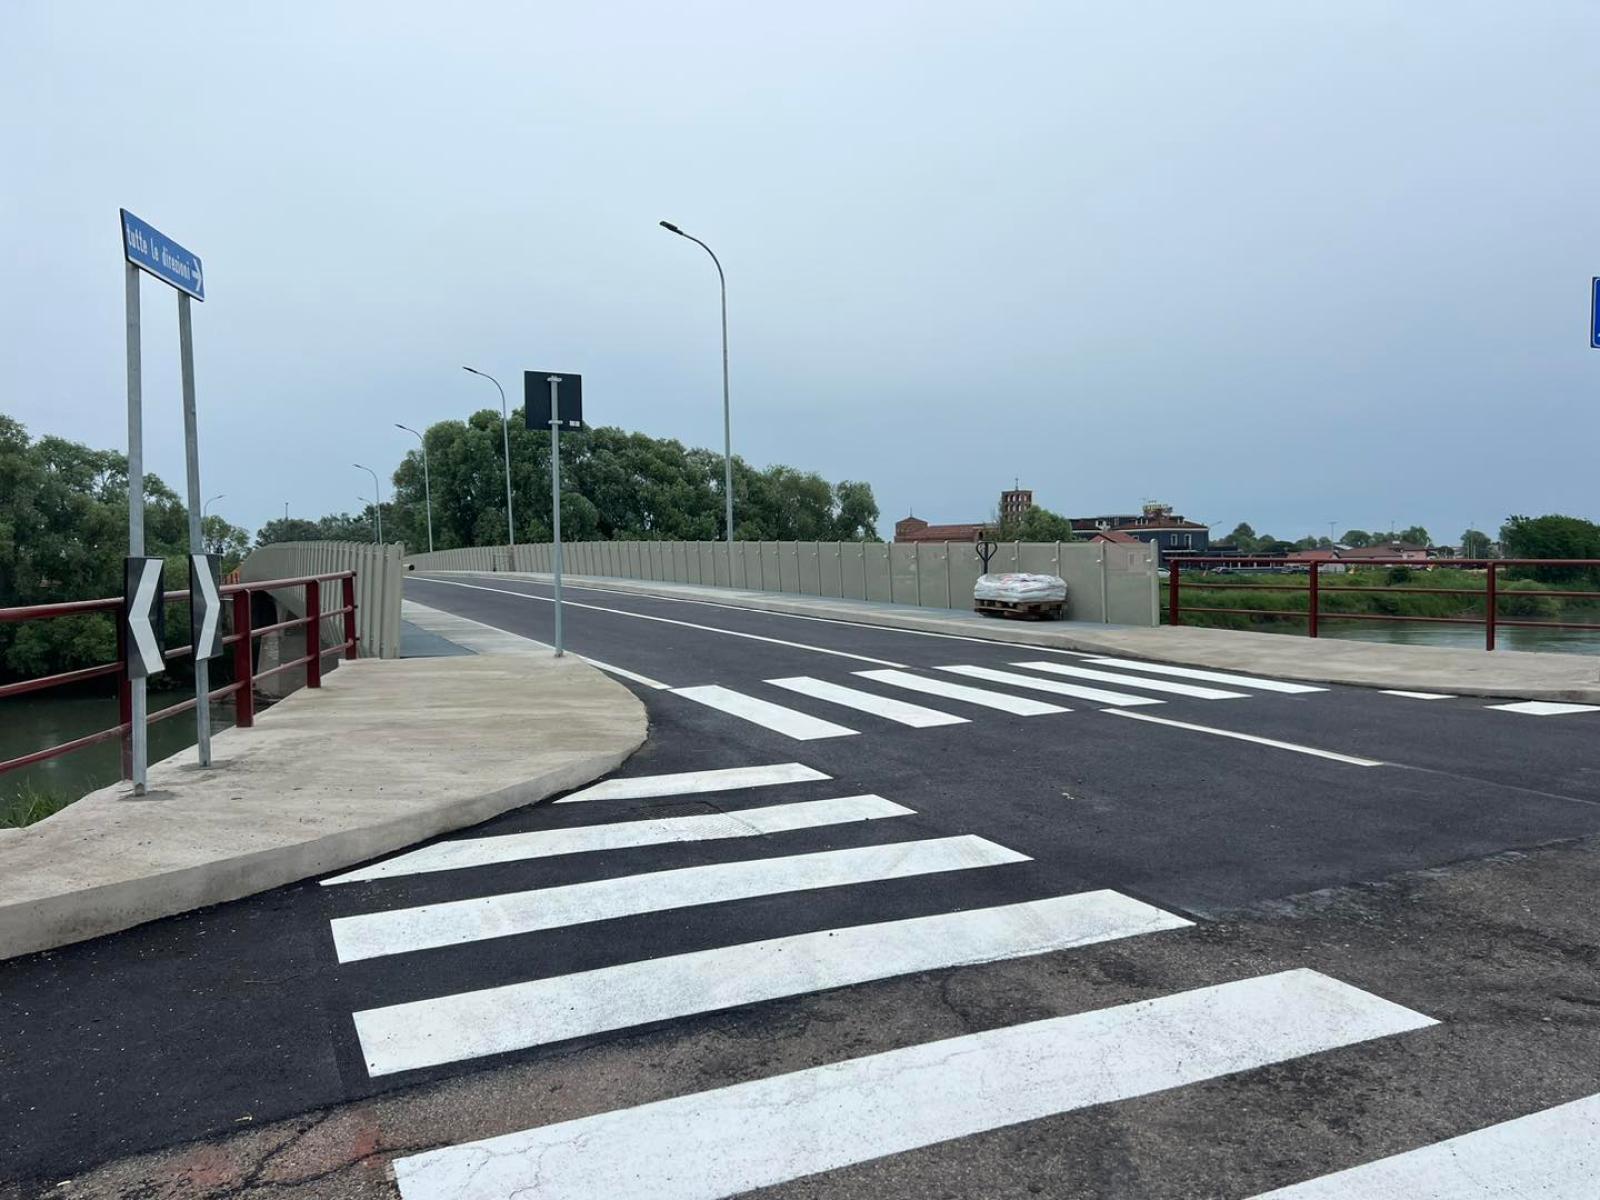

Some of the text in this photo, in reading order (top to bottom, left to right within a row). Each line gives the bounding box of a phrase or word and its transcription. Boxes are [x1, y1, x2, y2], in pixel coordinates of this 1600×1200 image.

[126, 223, 191, 280] tutte le direzioni
